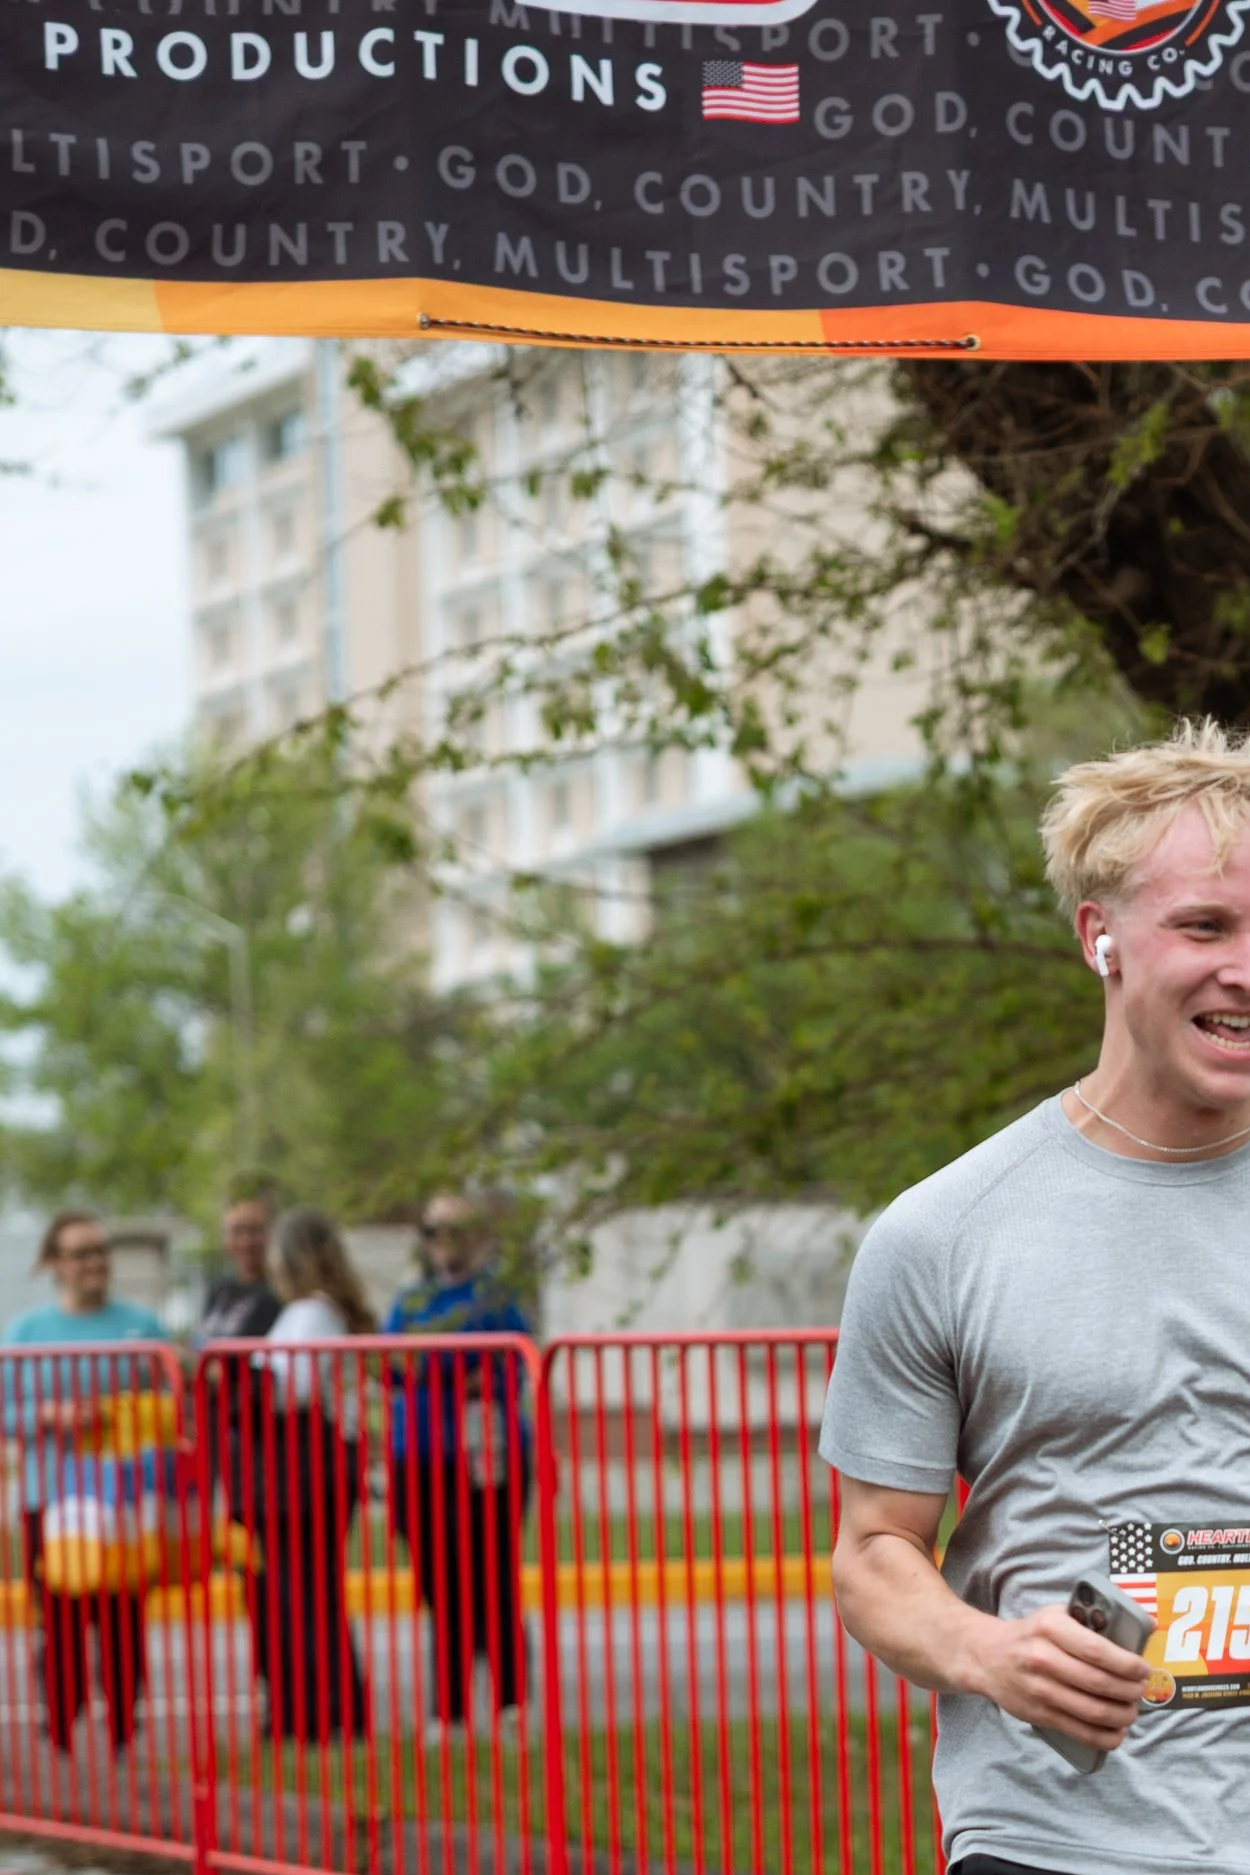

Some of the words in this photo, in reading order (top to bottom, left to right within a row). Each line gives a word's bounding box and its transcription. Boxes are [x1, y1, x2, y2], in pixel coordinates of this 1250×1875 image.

[44, 21, 667, 111] PRODUCTIONS
[1042, 24, 1133, 76] RACING
[813, 91, 977, 139] GOD,
[11, 128, 367, 186] LTISPORT
[438, 145, 602, 211] GOD,
[634, 170, 982, 218] COUNTRY,
[95, 218, 461, 271] COUNTRY,
[494, 232, 950, 297] MULTISPORT
